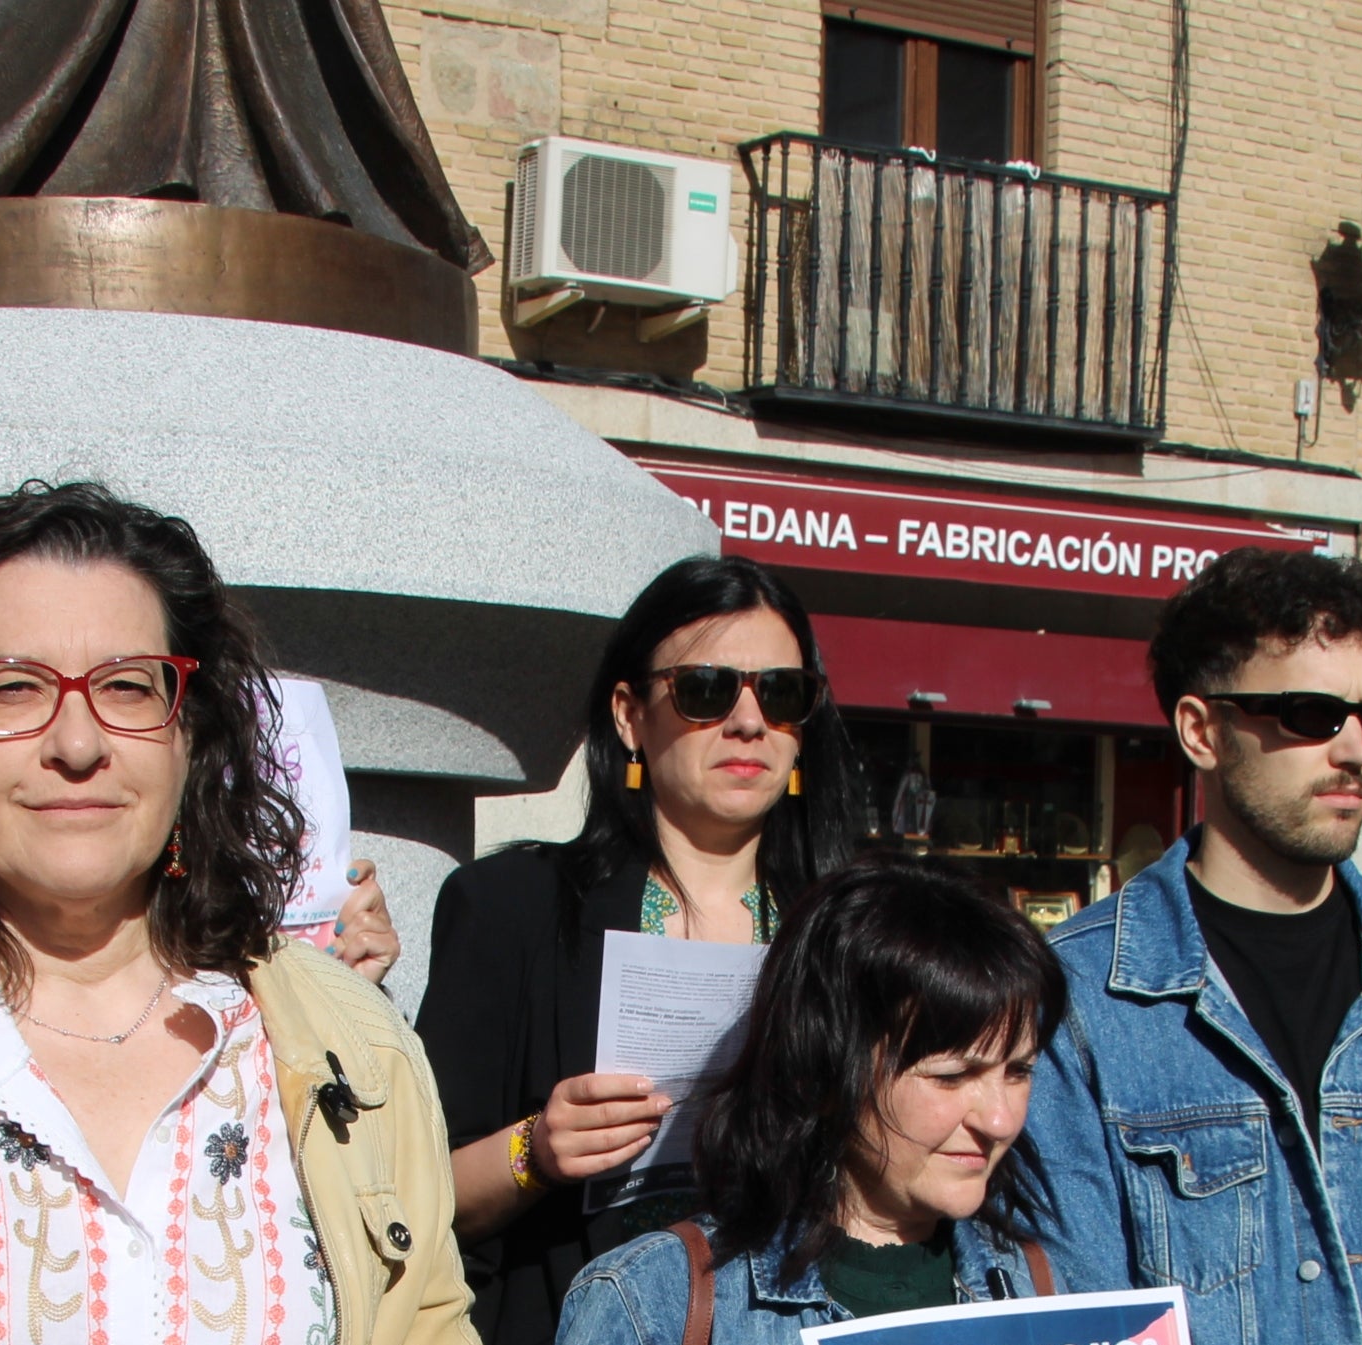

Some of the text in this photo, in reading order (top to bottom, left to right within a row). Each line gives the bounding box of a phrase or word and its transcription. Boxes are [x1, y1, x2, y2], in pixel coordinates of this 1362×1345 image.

[681, 496, 858, 551] EDANA
[898, 518, 1142, 577] FABRICACIÓN
[1151, 545, 1227, 581] PRO
